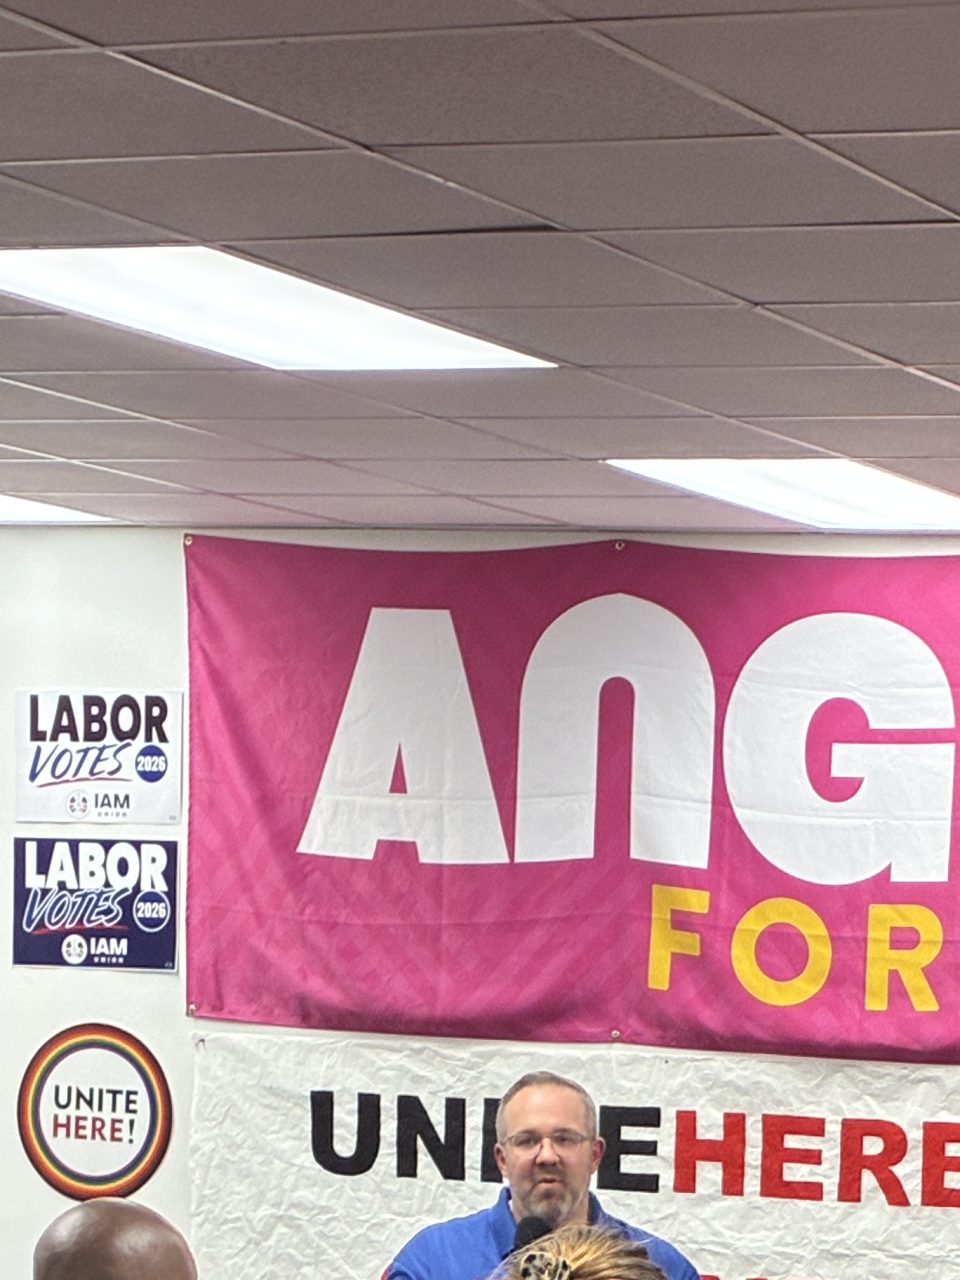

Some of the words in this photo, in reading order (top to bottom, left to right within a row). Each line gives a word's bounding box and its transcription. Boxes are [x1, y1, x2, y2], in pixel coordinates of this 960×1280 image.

[30, 694, 169, 743] LABOR
[29, 742, 132, 783] VOTES
[137, 755, 166, 772] 2026
[94, 793, 130, 809] IAM
[25, 840, 169, 892] LABOR
[23, 887, 132, 933] VOTES
[137, 902, 166, 918] 2026
[90, 937, 128, 956] IAM
[647, 883, 943, 1012] FOR
[54, 1084, 139, 1114] UNITE
[52, 1113, 136, 1144] HERE!
